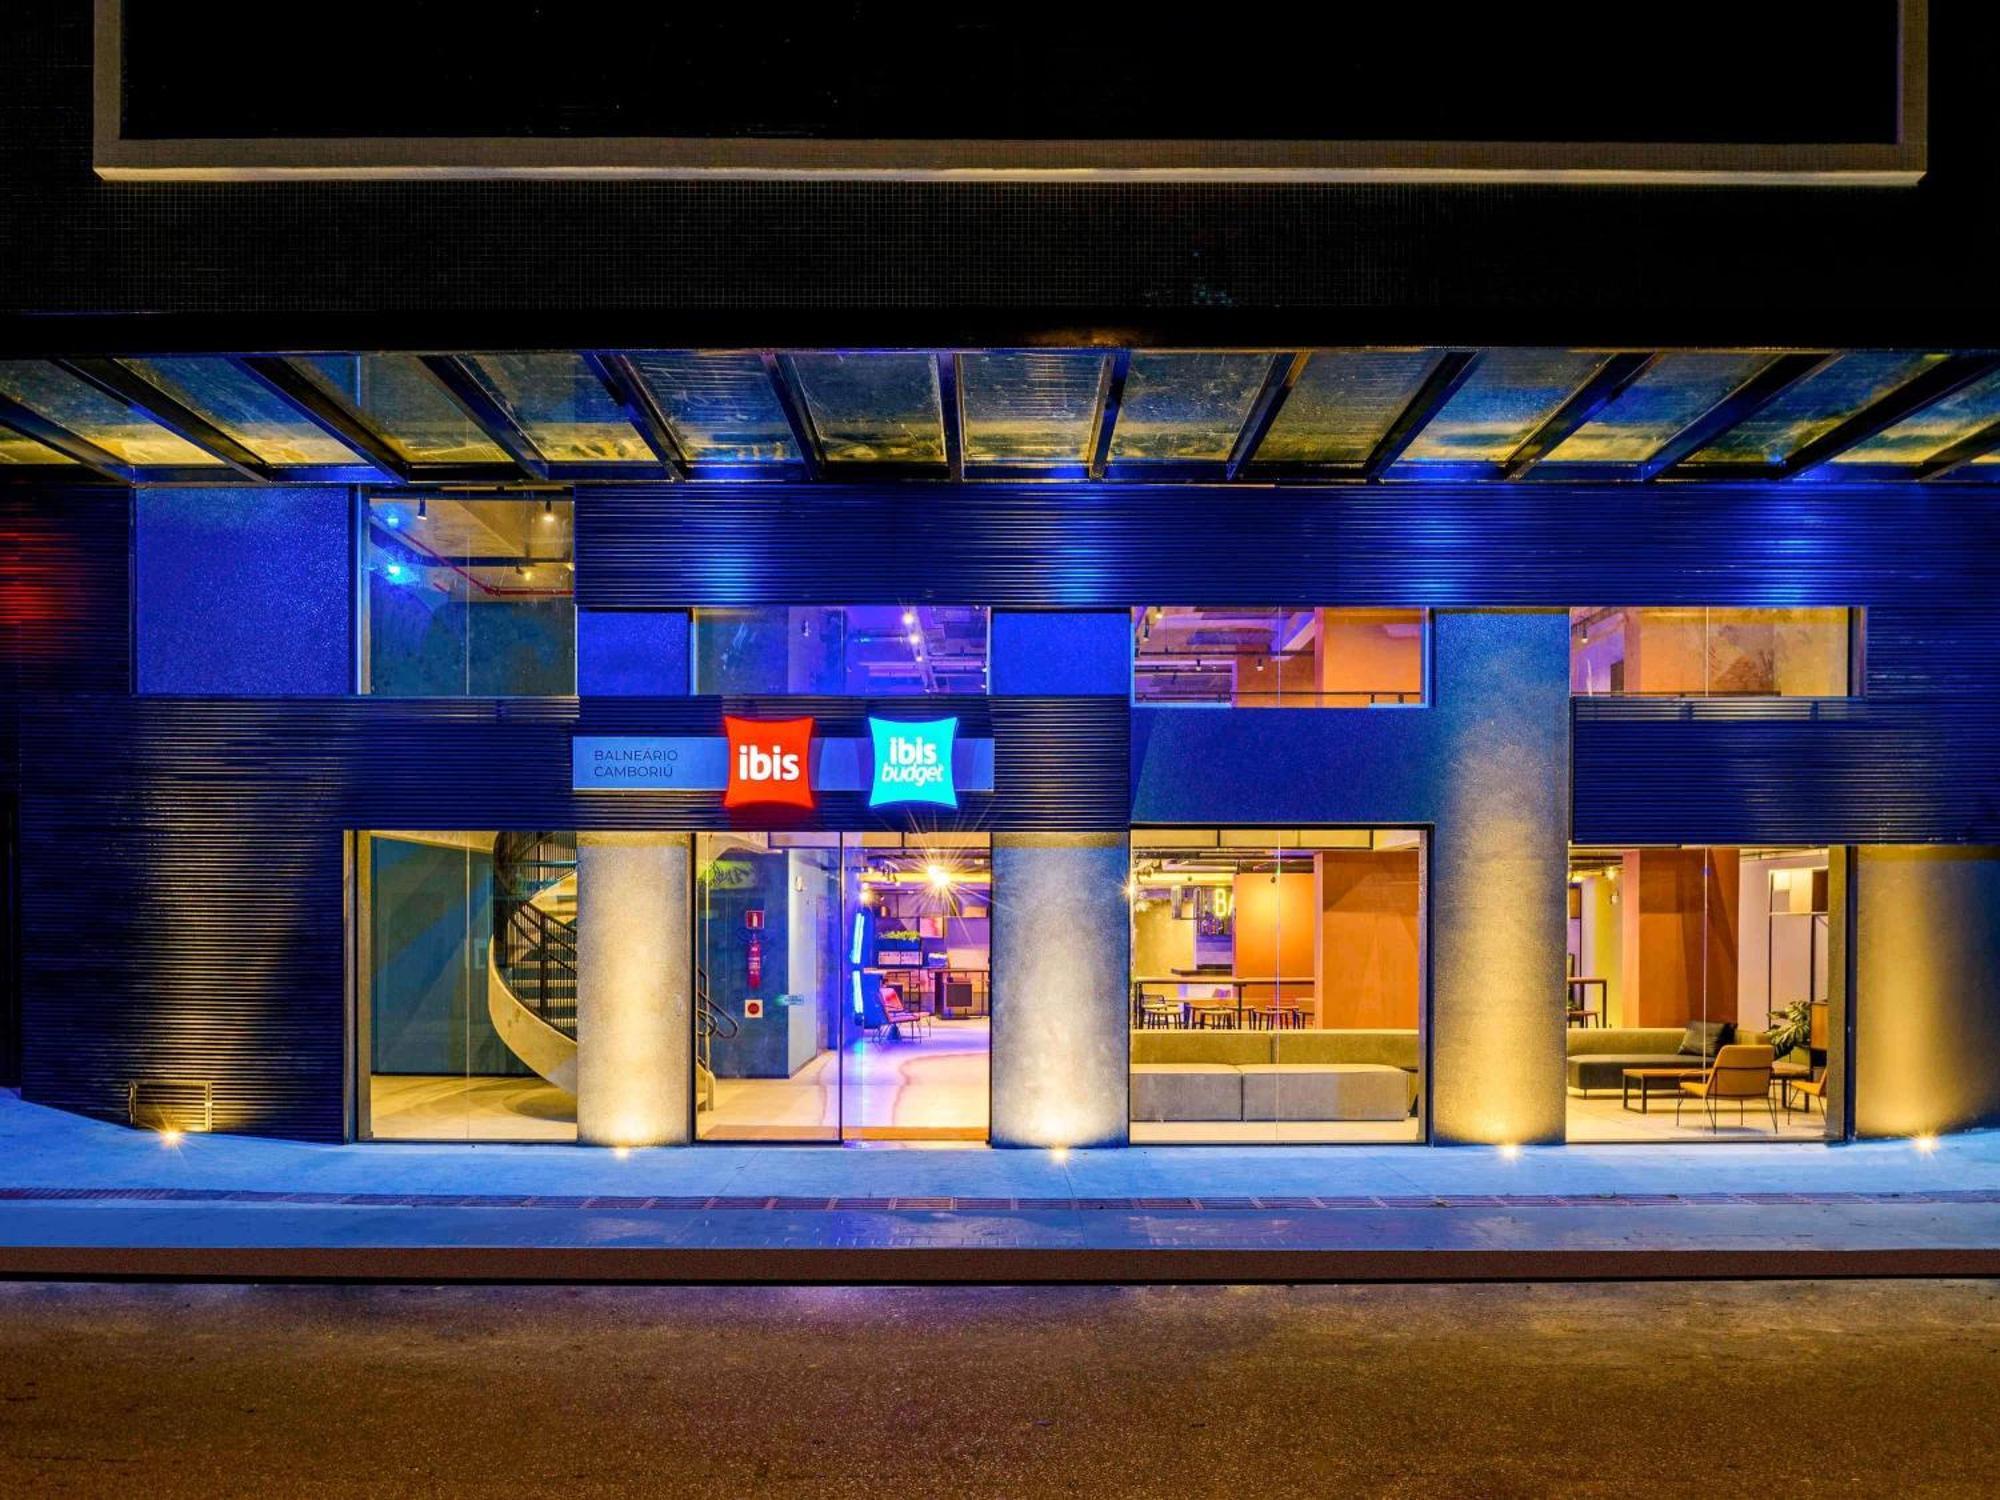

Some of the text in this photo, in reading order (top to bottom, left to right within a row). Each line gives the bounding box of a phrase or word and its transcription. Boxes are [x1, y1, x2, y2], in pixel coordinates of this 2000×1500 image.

[593, 747, 679, 761] BALNEÁRIO
[739, 744, 800, 781] ibis
[890, 737, 937, 765] ibis
[594, 763, 673, 777] CAMBORIÚ
[881, 762, 944, 787] budget
